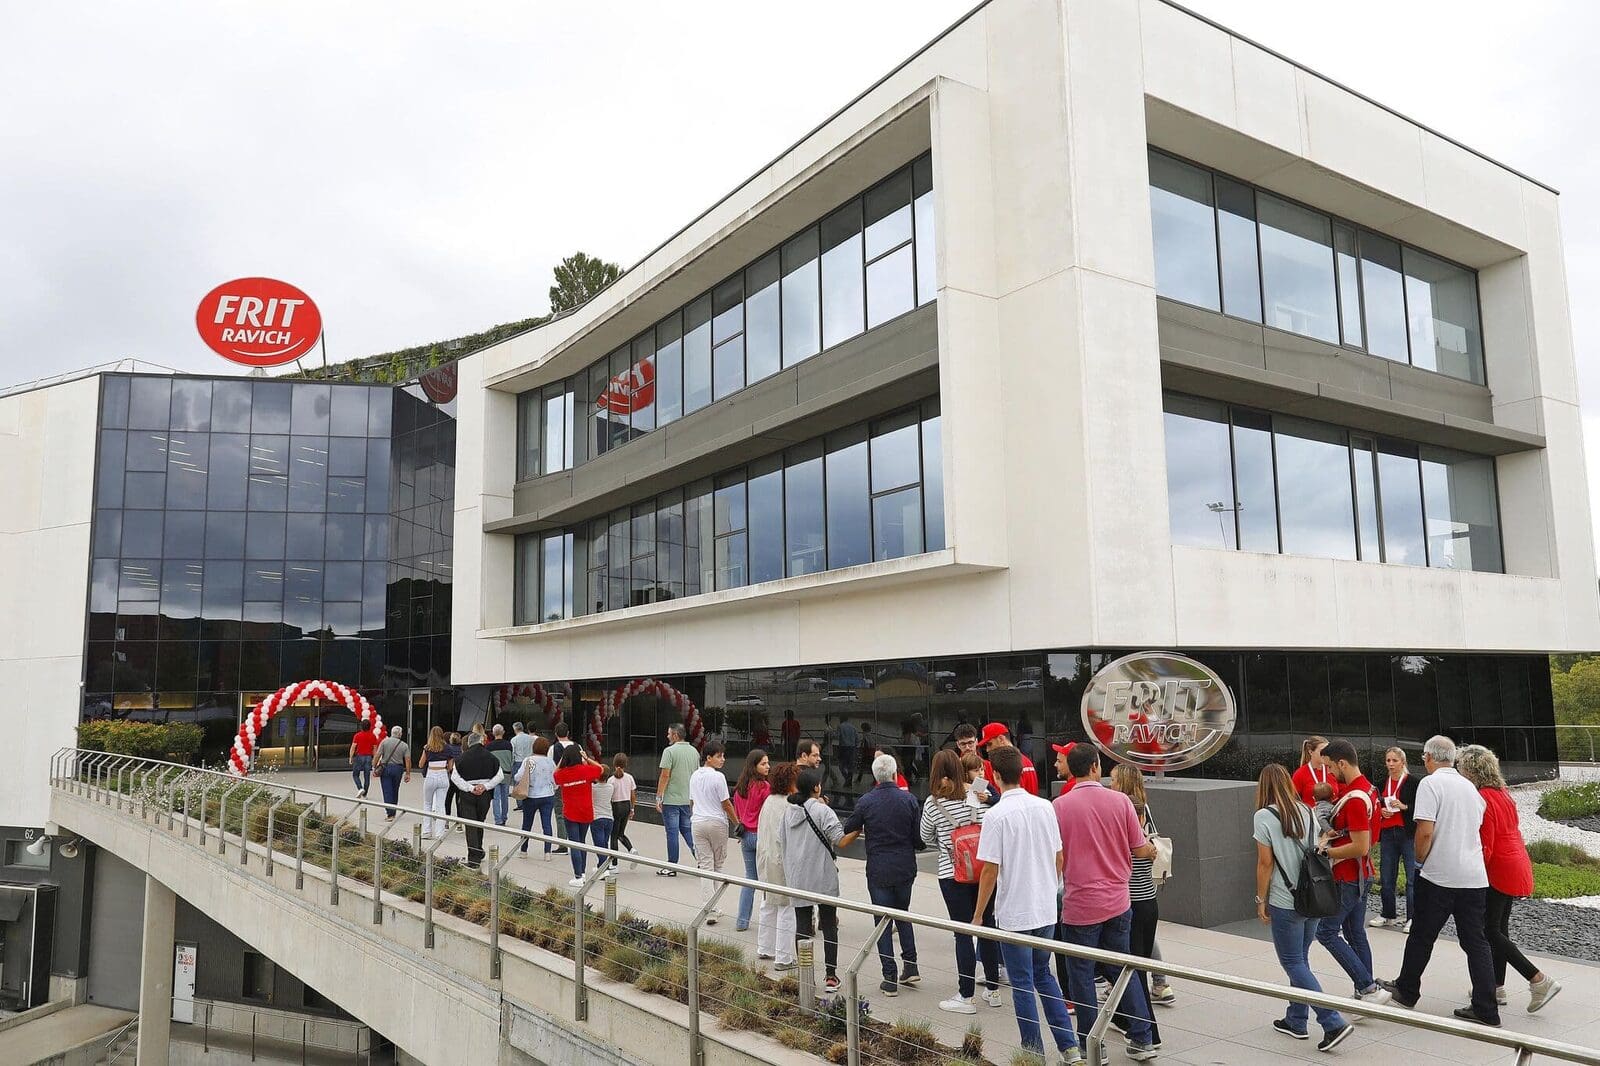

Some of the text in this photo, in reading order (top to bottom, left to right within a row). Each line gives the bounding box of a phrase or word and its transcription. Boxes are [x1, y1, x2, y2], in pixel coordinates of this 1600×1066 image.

[214, 295, 305, 327] FRIT
[221, 328, 291, 345] RAVICH
[1102, 679, 1212, 721] FRIT
[1113, 722, 1198, 744] RAVICH
[25, 829, 34, 840] 62
